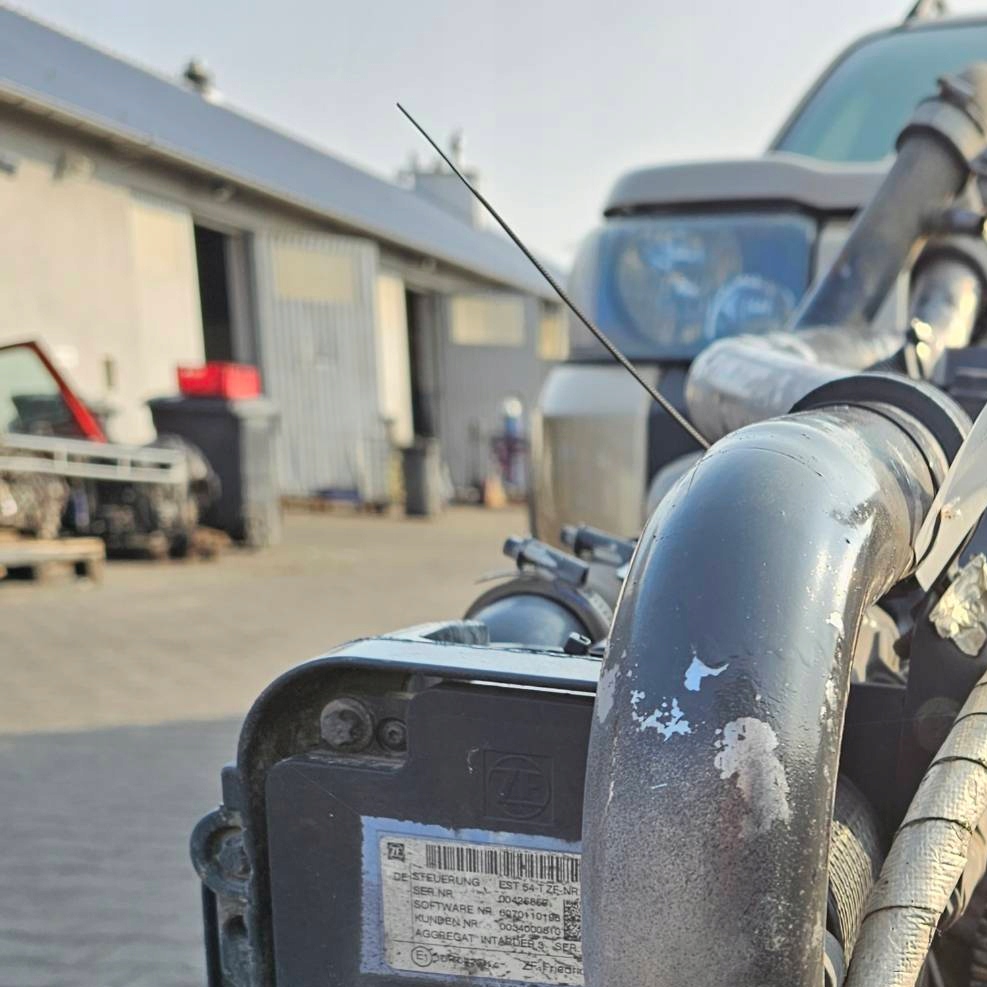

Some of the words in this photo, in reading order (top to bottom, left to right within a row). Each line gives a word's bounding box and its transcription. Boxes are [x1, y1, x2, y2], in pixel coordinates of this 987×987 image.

[412, 871, 480, 887] STEUERUNG
[499, 880, 519, 890] EST
[414, 900, 473, 914] SOFTWARE
[415, 914, 460, 926] KUNDEN
[415, 928, 475, 942] AGGREGAT
[481, 935, 534, 948] INTARDER
